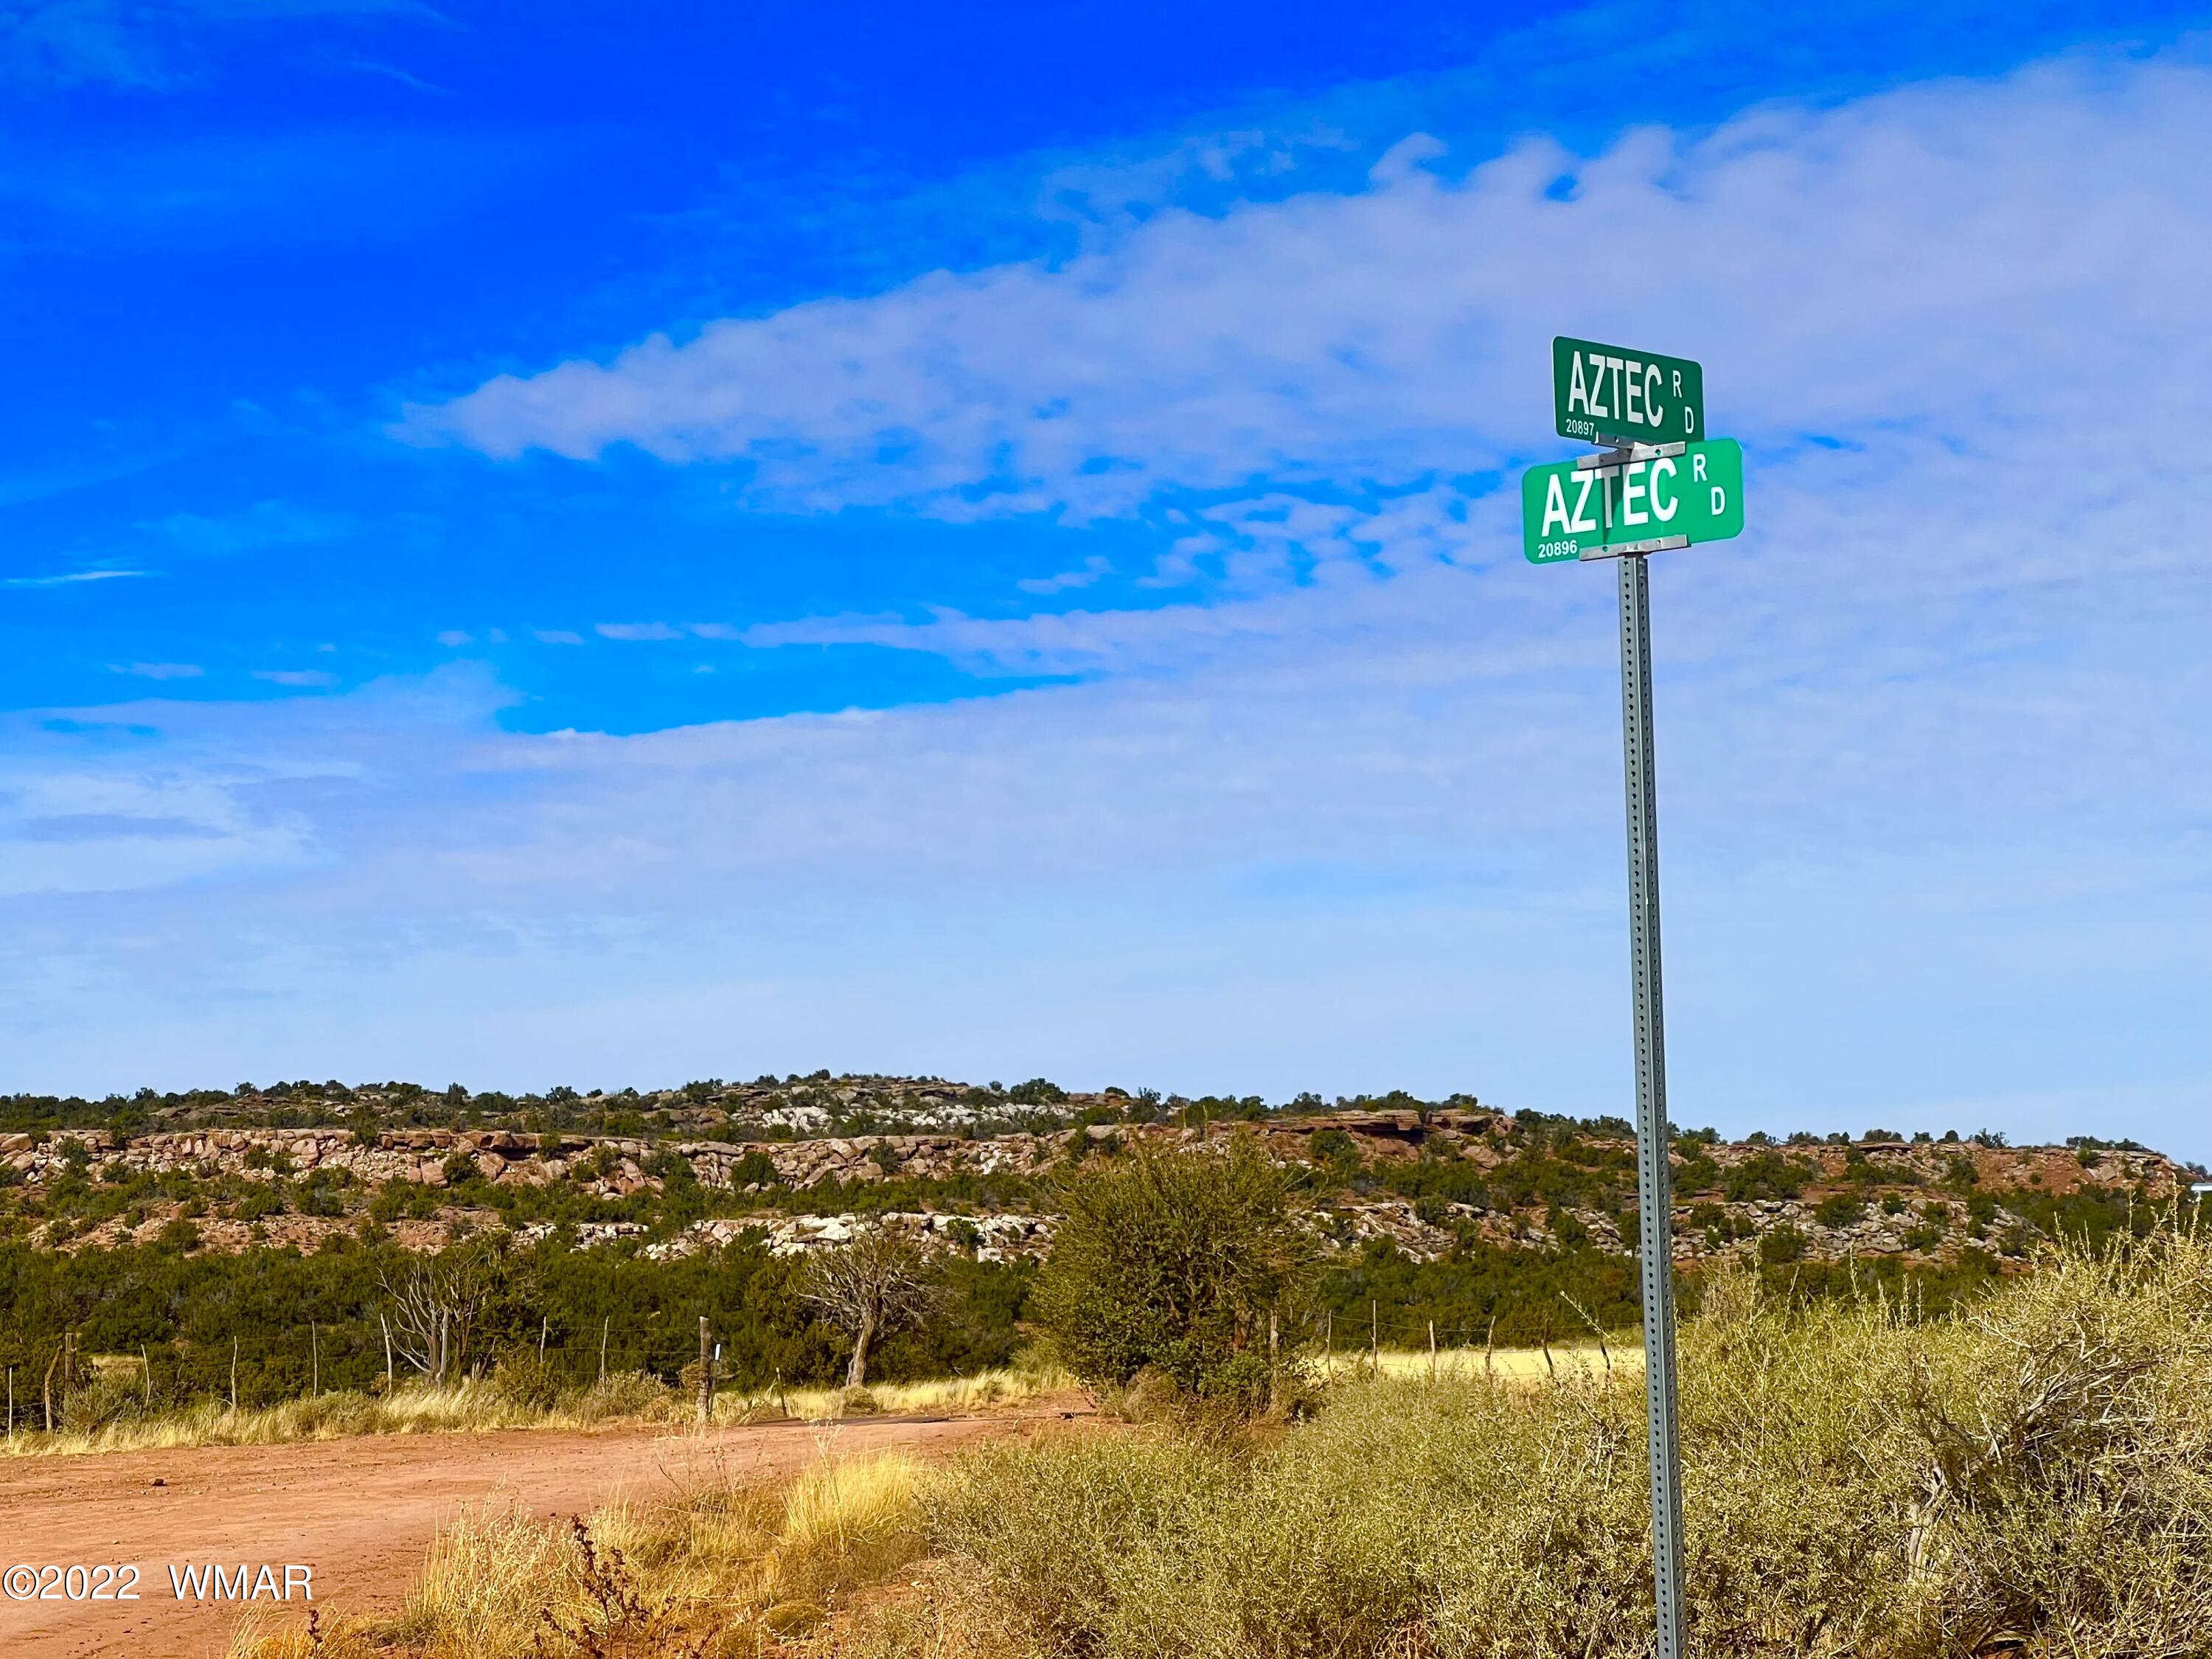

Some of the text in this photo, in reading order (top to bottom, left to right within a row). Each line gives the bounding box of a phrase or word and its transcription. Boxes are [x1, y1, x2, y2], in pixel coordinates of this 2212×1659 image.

[1568, 350, 1663, 428] AZTEC
[1565, 417, 1594, 437] 20897
[1541, 457, 1679, 538] AZTEC
[1537, 540, 1578, 558] 20896
